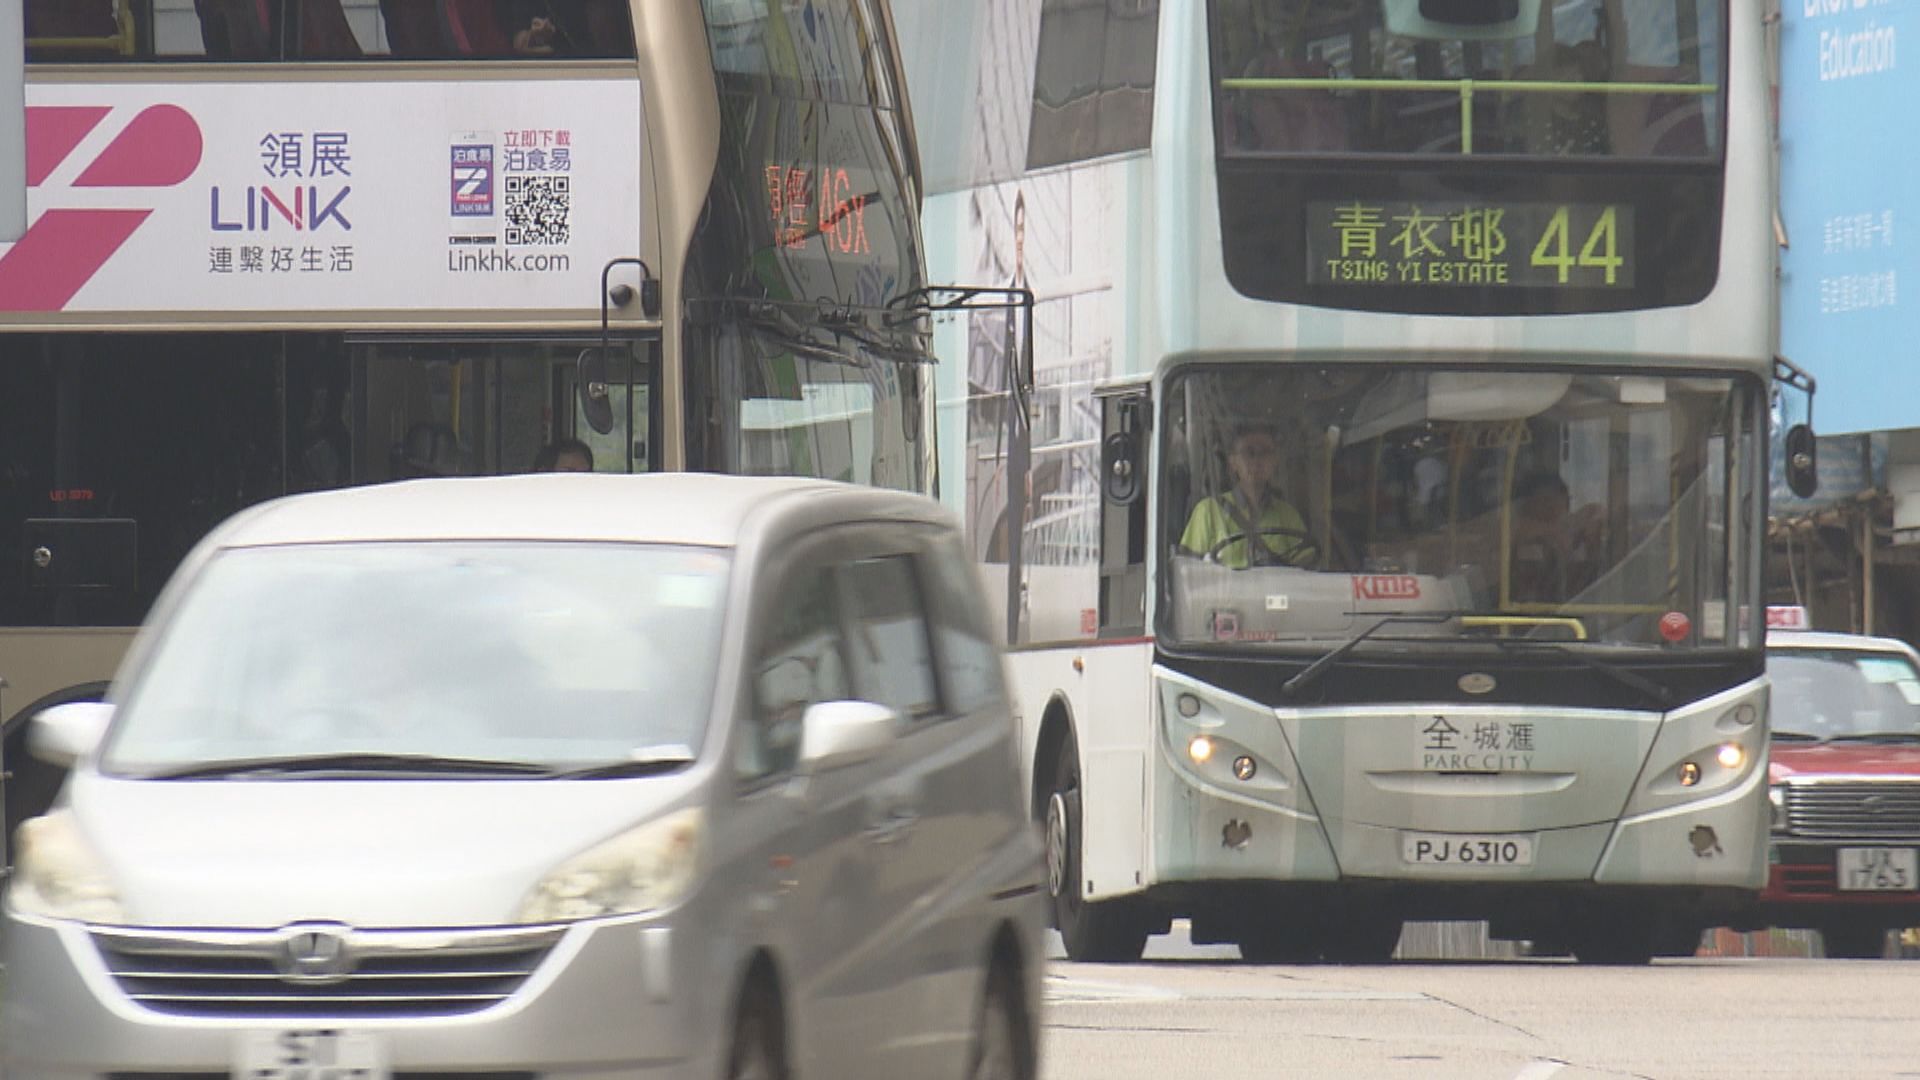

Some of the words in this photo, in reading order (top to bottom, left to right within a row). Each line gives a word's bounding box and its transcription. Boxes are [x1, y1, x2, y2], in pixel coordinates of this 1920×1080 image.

[1820, 24, 1896, 81] Education
[503, 130, 571, 147] 立即下載
[260, 132, 351, 178] 領展
[503, 148, 571, 171] 泊食易
[211, 186, 352, 231] LINK
[1331, 203, 1507, 263] 青衣邨
[1530, 205, 1624, 283] 44
[209, 246, 354, 273] 連繫好生活
[449, 248, 570, 271] Linkhk.com
[1327, 260, 1389, 282] TSING
[1396, 260, 1422, 282] YI
[1428, 261, 1509, 283] ESTATE
[1352, 575, 1421, 600] KMB
[1424, 754, 1476, 769] PARC
[1483, 754, 1534, 769] CITY
[1416, 840, 1449, 862] PJ
[1458, 841, 1518, 862] 6310
